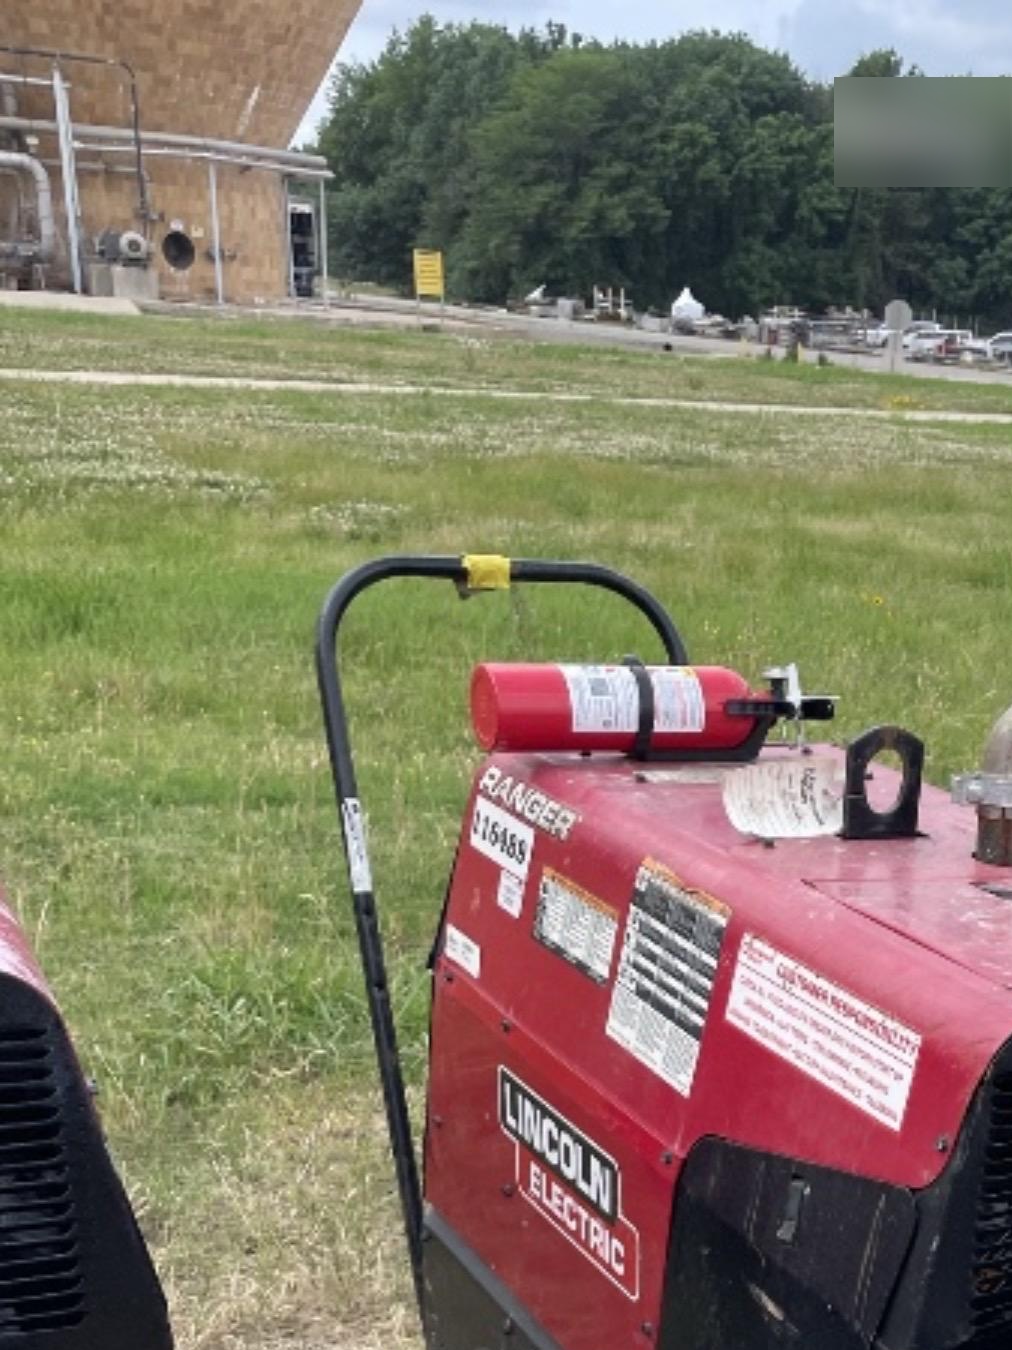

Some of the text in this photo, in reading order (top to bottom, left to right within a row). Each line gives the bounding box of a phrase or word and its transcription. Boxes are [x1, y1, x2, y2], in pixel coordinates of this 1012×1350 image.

[479, 764, 577, 841] RANGER
[504, 1082, 611, 1214] LINCOLN
[530, 1160, 625, 1276] ELECTRIC
